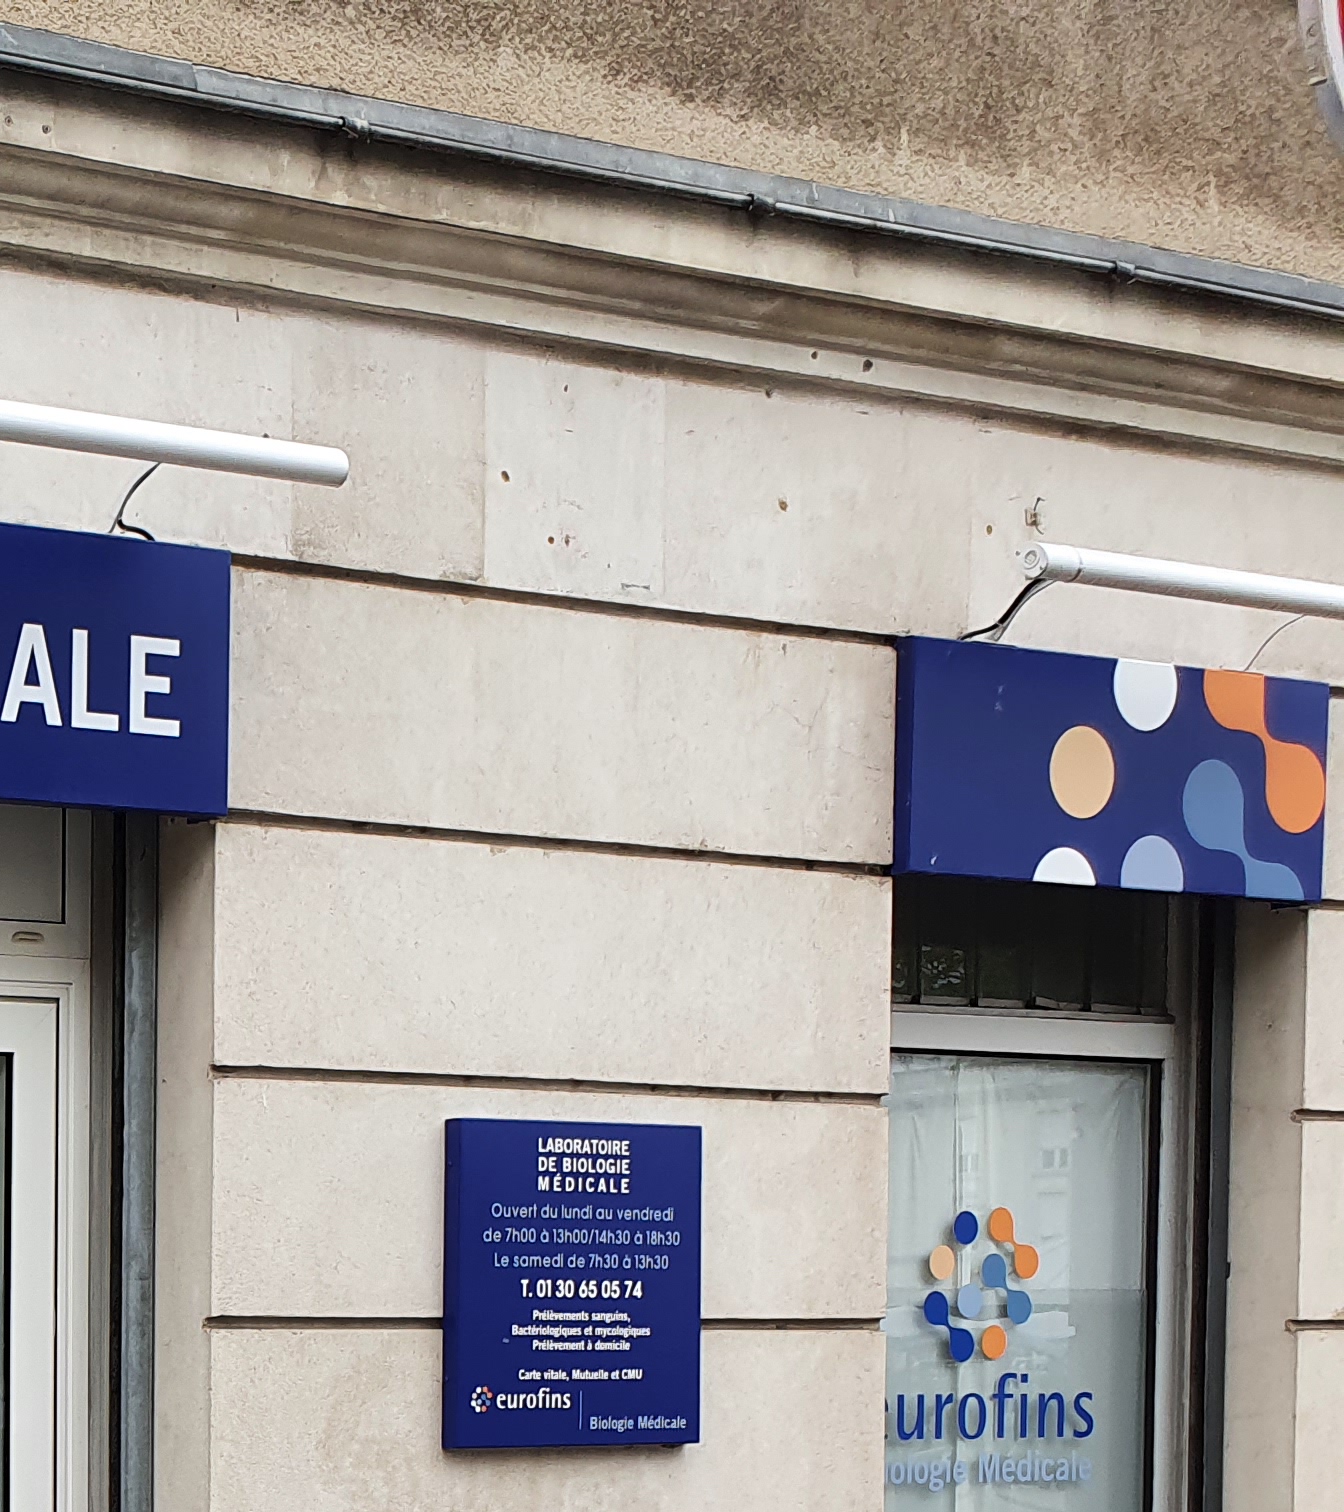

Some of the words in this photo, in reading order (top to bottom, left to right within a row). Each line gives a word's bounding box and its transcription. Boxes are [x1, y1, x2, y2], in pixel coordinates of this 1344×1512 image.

[538, 1138, 630, 1156] LABORATOIRE
[538, 1157, 557, 1172] DE
[563, 1158, 630, 1174] BIOLOGIE
[538, 1173, 630, 1193] MÉDICALE
[491, 1203, 537, 1219] Ouvert
[541, 1204, 558, 1219] du
[562, 1205, 592, 1220] lundi
[596, 1207, 613, 1220] au
[617, 1206, 674, 1222] vendredi
[483, 1228, 502, 1243] de
[504, 1228, 536, 1243] 7h00
[541, 1229, 551, 1243] à
[553, 1229, 630, 1246] 13h00/14h30
[634, 1231, 643, 1245] à
[646, 1230, 681, 1246] 18h30
[494, 1253, 509, 1267] Le
[513, 1253, 564, 1268] samedi
[568, 1254, 585, 1268] de
[589, 1254, 618, 1269] 7h30
[623, 1255, 632, 1269] à
[634, 1254, 669, 1269] 13h30
[520, 1279, 533, 1298] T.
[537, 1280, 553, 1298] 01
[555, 1280, 574, 1298] 30
[578, 1280, 597, 1298] 65
[602, 1280, 620, 1299] 05
[624, 1281, 643, 1299] 74
[532, 1310, 589, 1321] Prélèvements
[512, 1324, 582, 1338] Bactériologiques
[584, 1326, 593, 1336] et
[595, 1326, 651, 1337] mycologiques
[532, 1339, 585, 1351] Prélèvement
[587, 1340, 593, 1351] à
[595, 1340, 630, 1351] domicile
[518, 1369, 541, 1380] Carte
[544, 1369, 569, 1382] vitale,
[572, 1370, 608, 1380] Mutuelle
[611, 1370, 619, 1380] et
[621, 1369, 643, 1380] CMU
[496, 1388, 571, 1409] eurofins
[590, 1416, 634, 1433] Biologie
[638, 1415, 687, 1430] Médicale
[885, 1372, 1094, 1441] urofins
[978, 1451, 1093, 1483] Médicale
